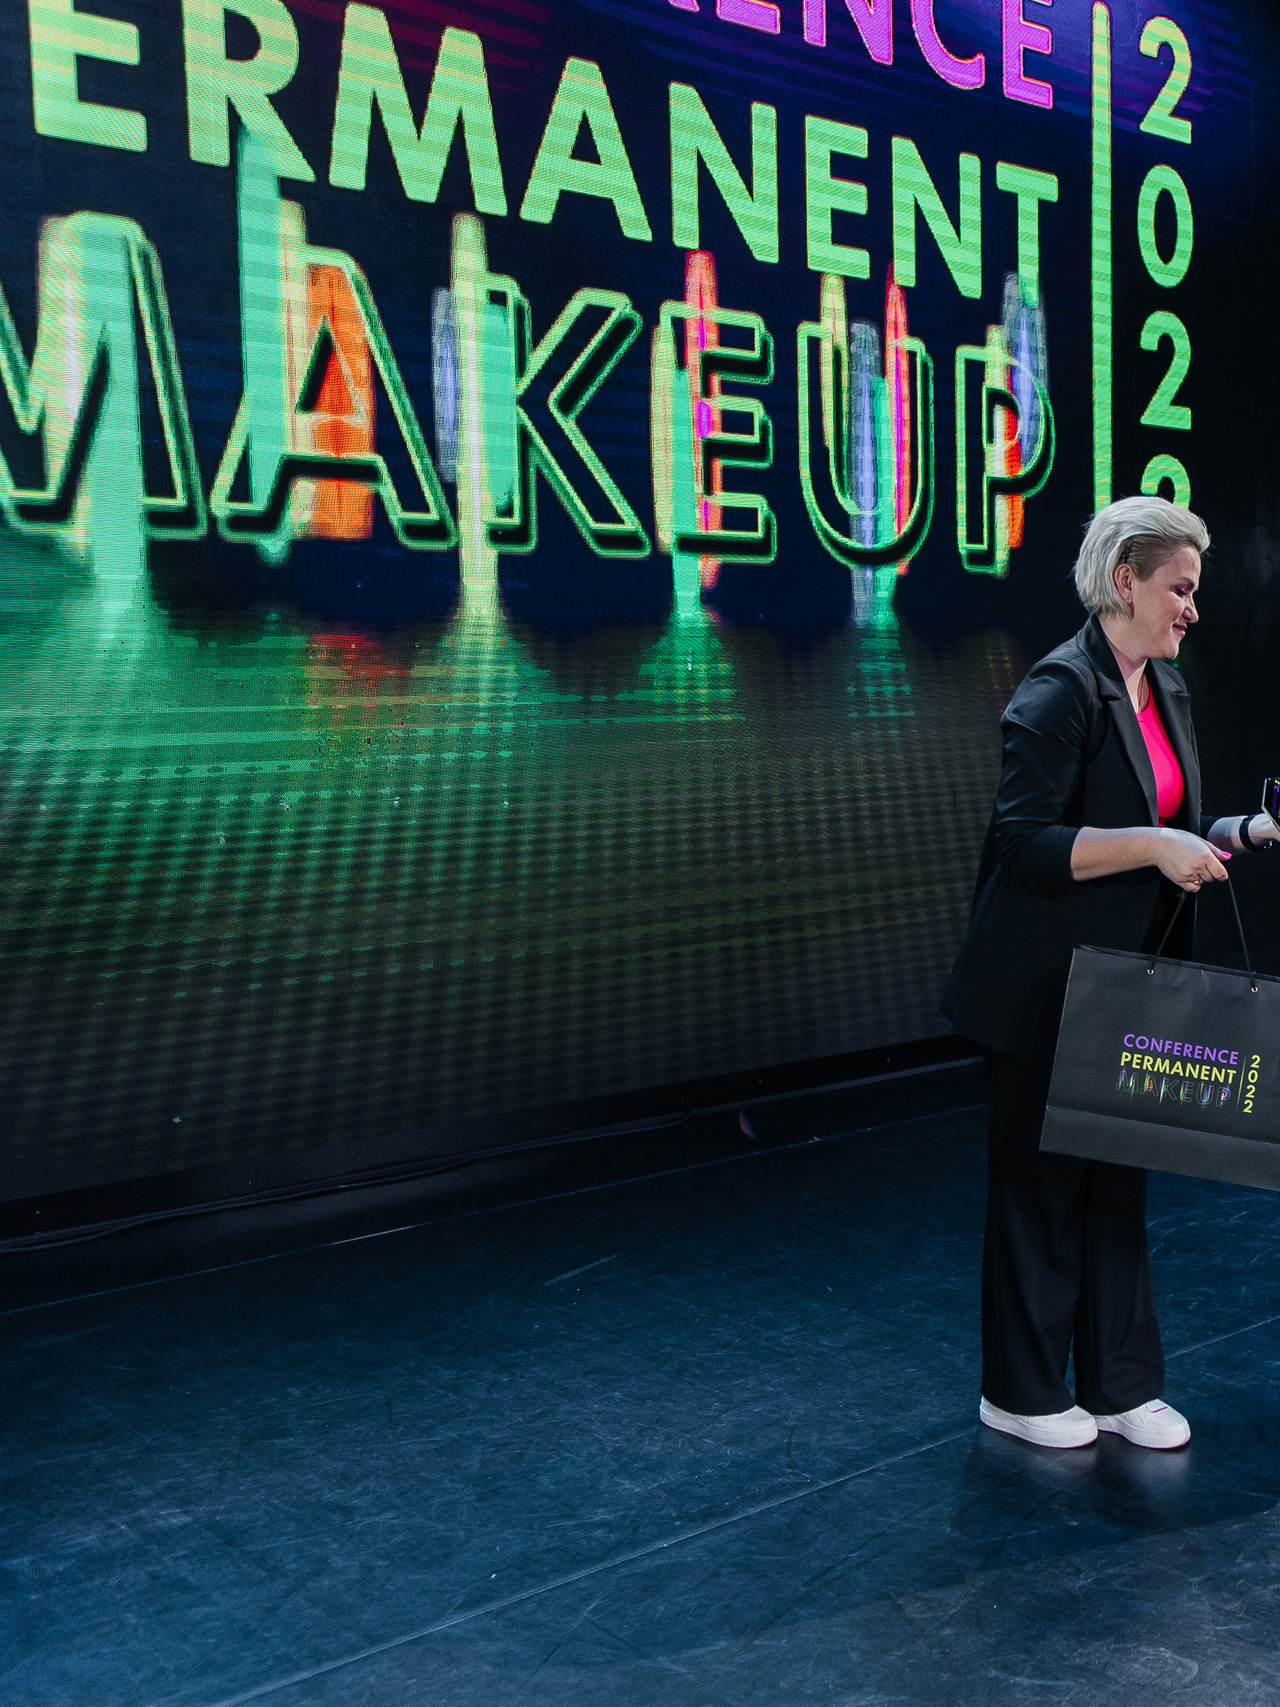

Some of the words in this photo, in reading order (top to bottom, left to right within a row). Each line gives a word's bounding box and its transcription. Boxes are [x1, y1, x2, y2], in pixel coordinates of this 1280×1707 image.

[1123, 1033, 1239, 1065] CONFERENCE
[1120, 1051, 1237, 1085] PERMANENT
[1242, 1054, 1261, 1114] 2022
[1115, 1069, 1232, 1108] MAKEUP
